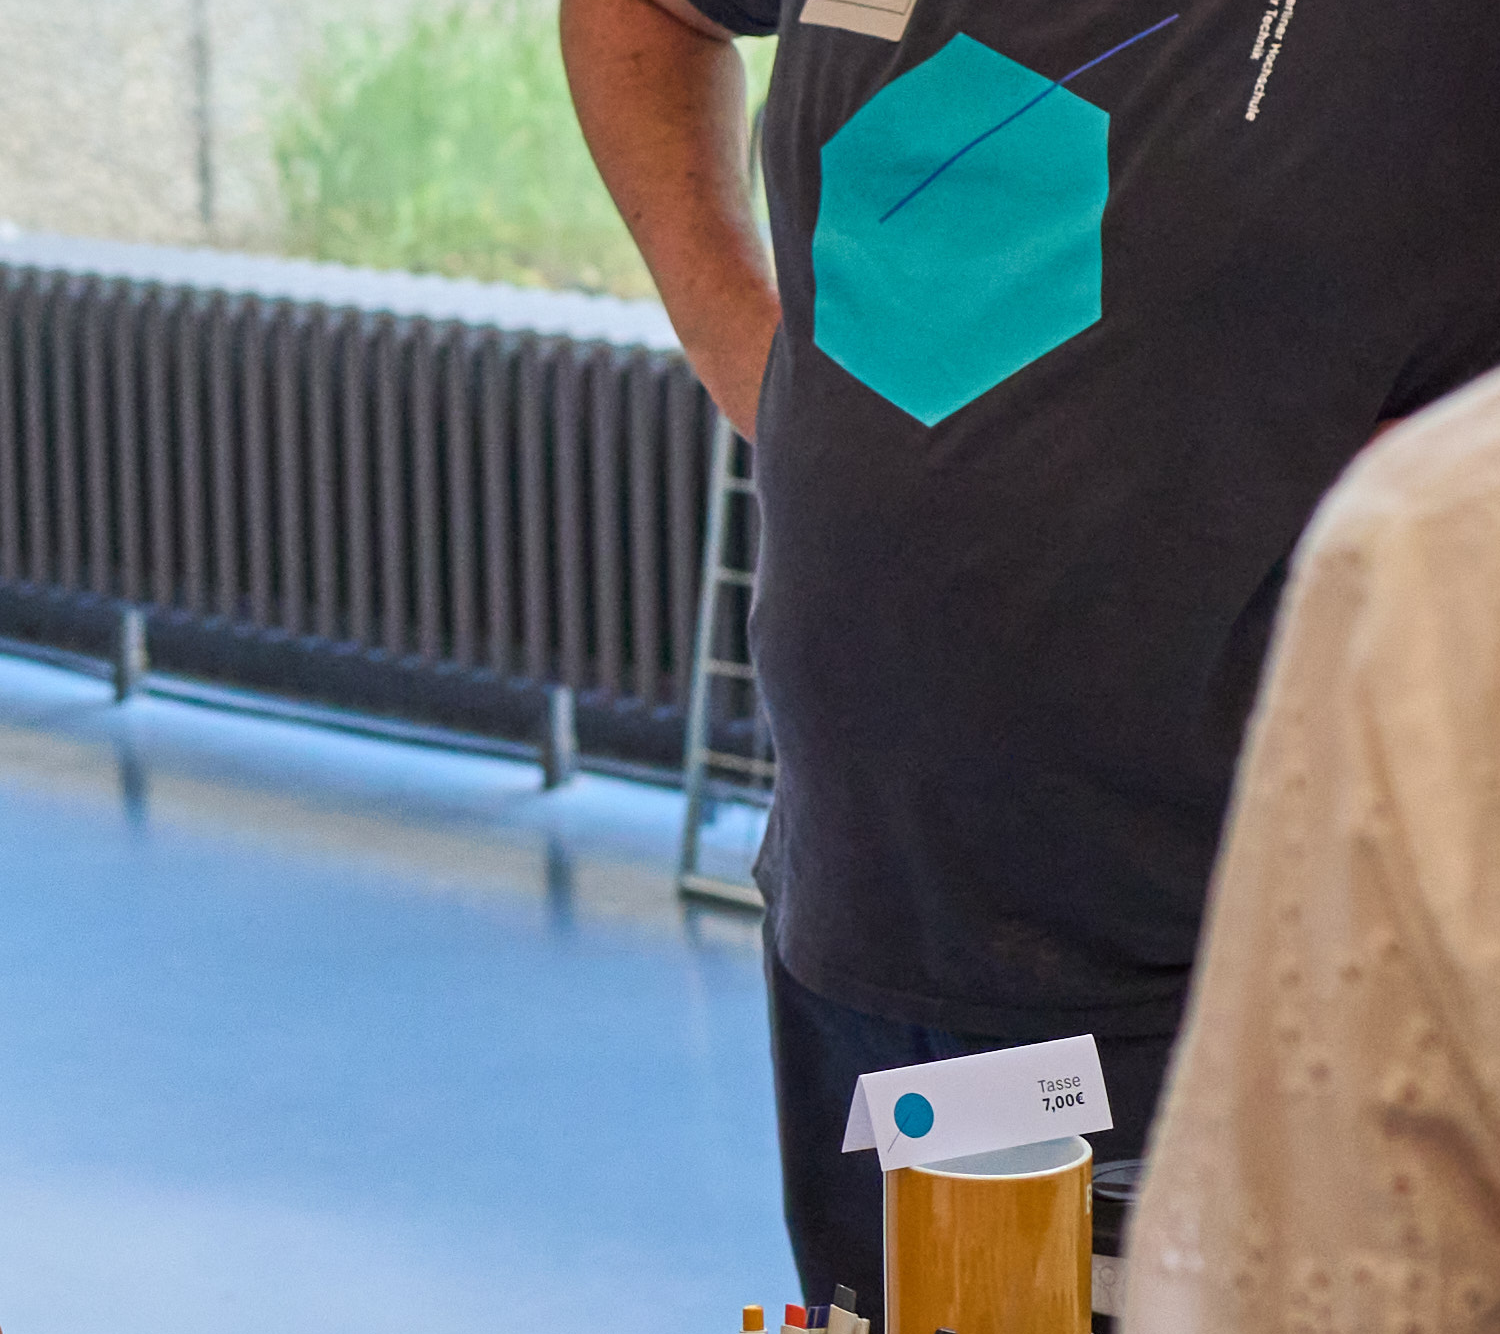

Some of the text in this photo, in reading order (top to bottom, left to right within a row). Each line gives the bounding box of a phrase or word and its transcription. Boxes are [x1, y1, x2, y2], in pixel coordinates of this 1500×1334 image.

[1249, 8, 1280, 61] Technik
[1244, 42, 1284, 122] Hochschule
[1037, 1076, 1082, 1093] Tasse
[1042, 1092, 1085, 1113] 7,00€
